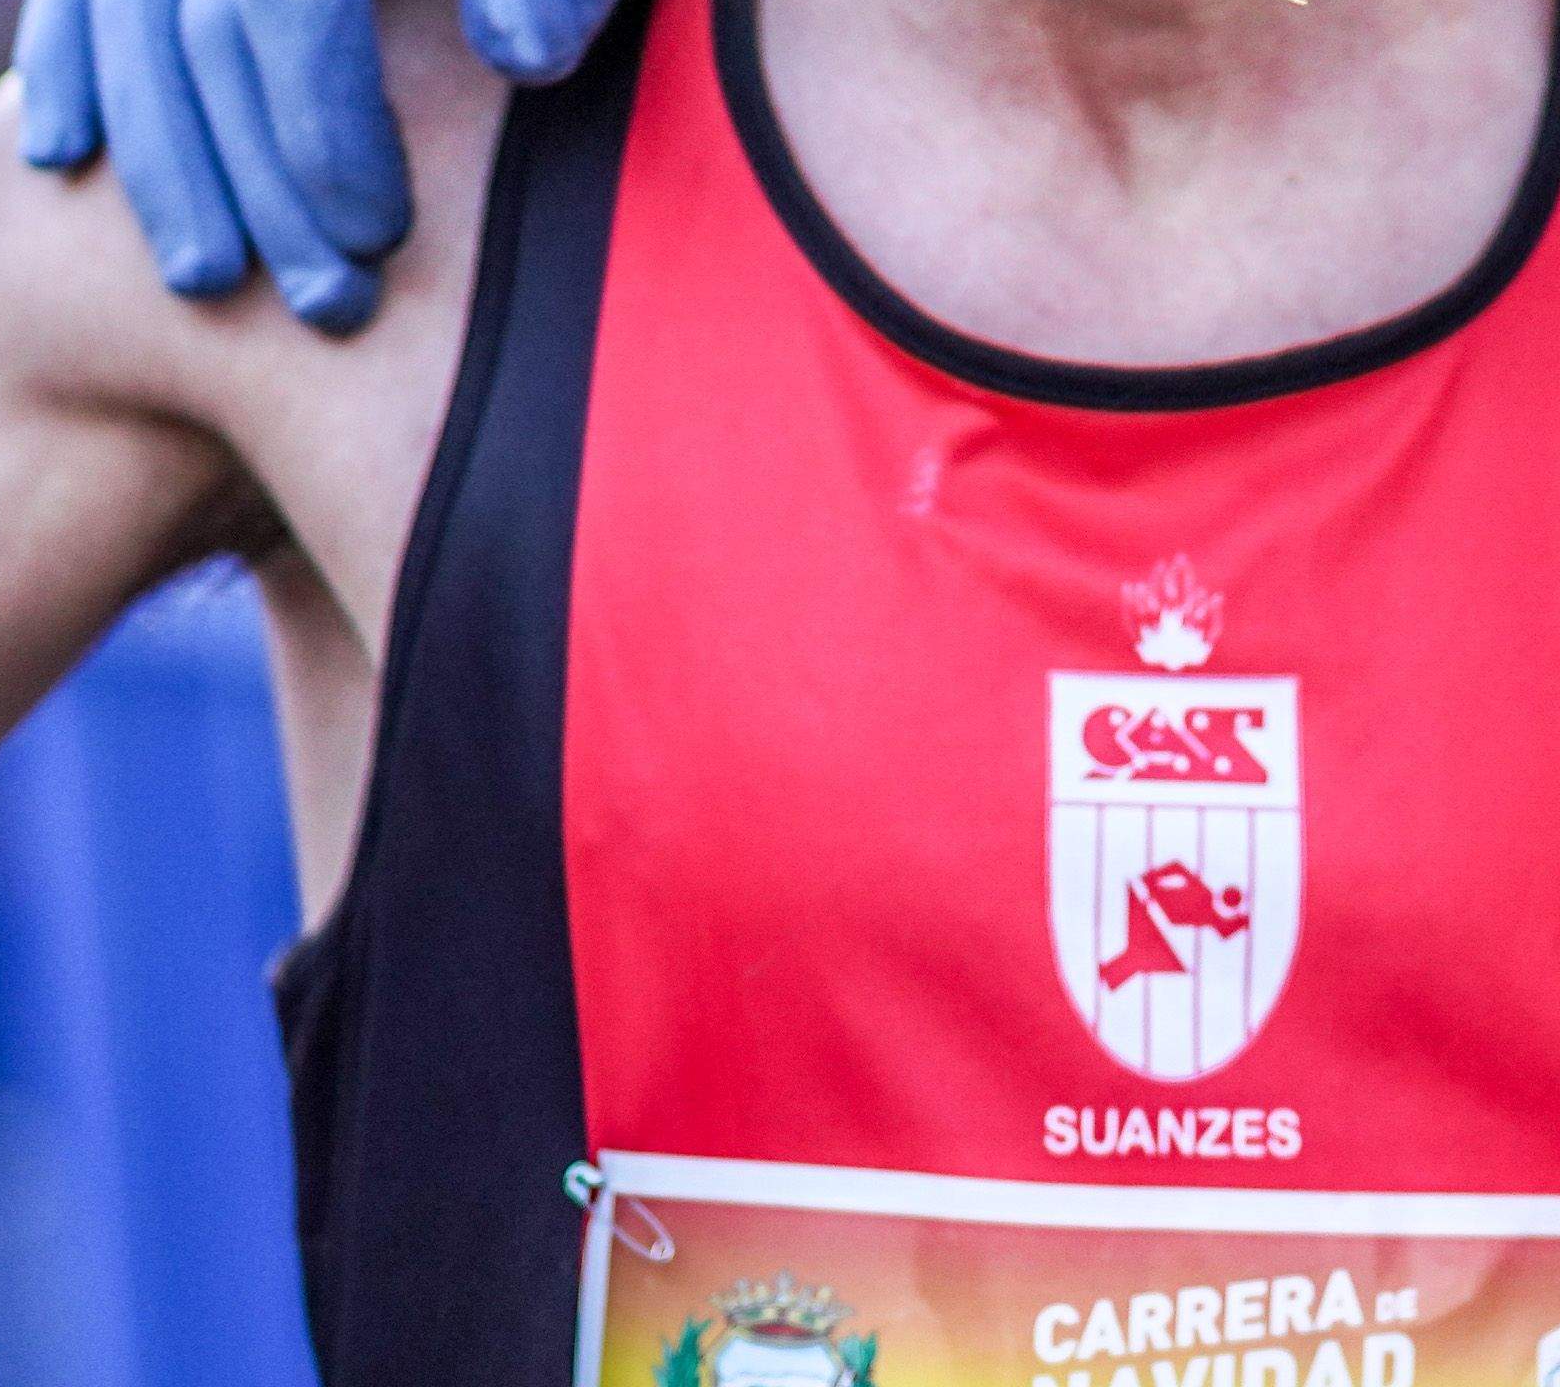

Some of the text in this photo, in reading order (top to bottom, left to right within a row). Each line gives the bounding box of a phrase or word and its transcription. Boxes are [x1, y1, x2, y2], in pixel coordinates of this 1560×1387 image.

[1042, 1104, 1303, 1159] SUANZES
[1032, 1268, 1419, 1365] CARRERA DE
